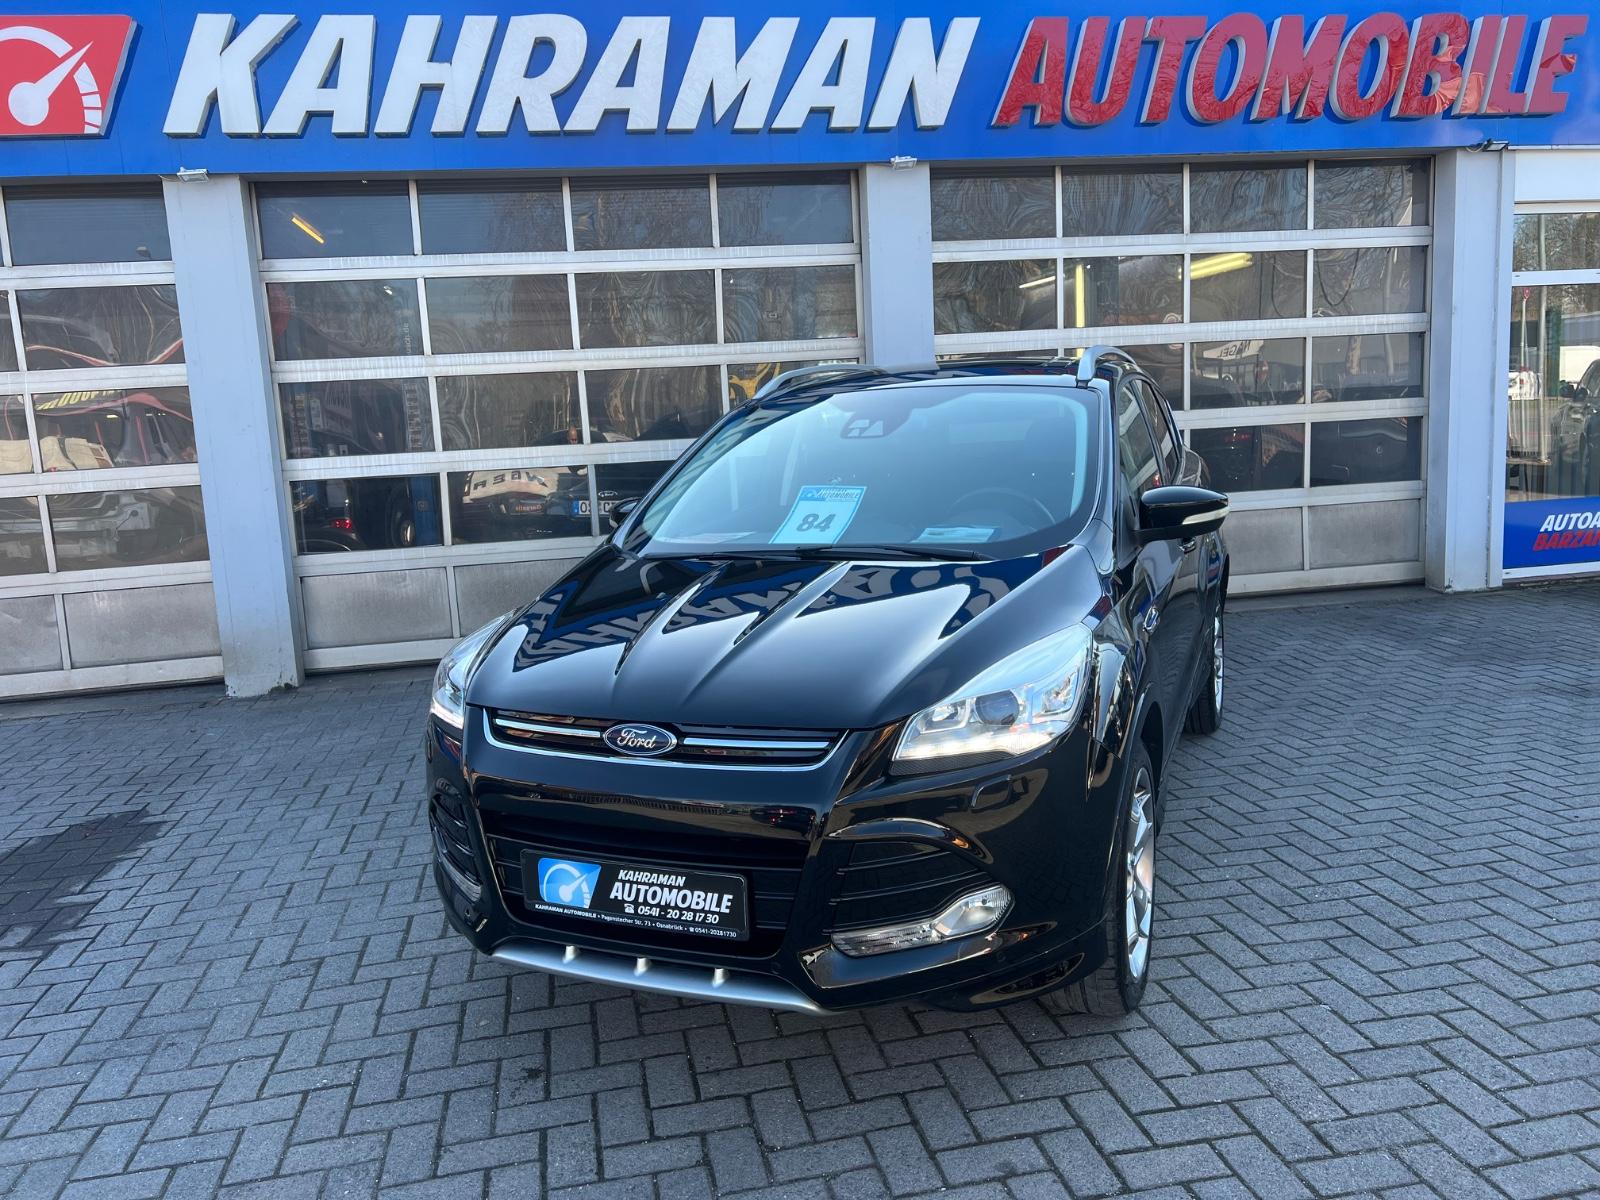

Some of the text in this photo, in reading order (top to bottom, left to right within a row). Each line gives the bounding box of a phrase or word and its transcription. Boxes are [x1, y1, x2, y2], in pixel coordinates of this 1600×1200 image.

[163, 13, 1588, 137] KAHRAMAN AUTOMOBILE
[796, 513, 836, 532] 84
[617, 728, 656, 749] Ford
[618, 869, 686, 887] KAHRAMAN
[610, 882, 733, 914] AUTOMOBILE
[535, 903, 563, 913] KAHRAMAN
[564, 908, 597, 919] AUTOMOBILE
[638, 906, 659, 917] 0541
[667, 909, 680, 919] 20
[681, 911, 693, 921] 28
[695, 913, 705, 922] 17
[705, 914, 719, 924] 30
